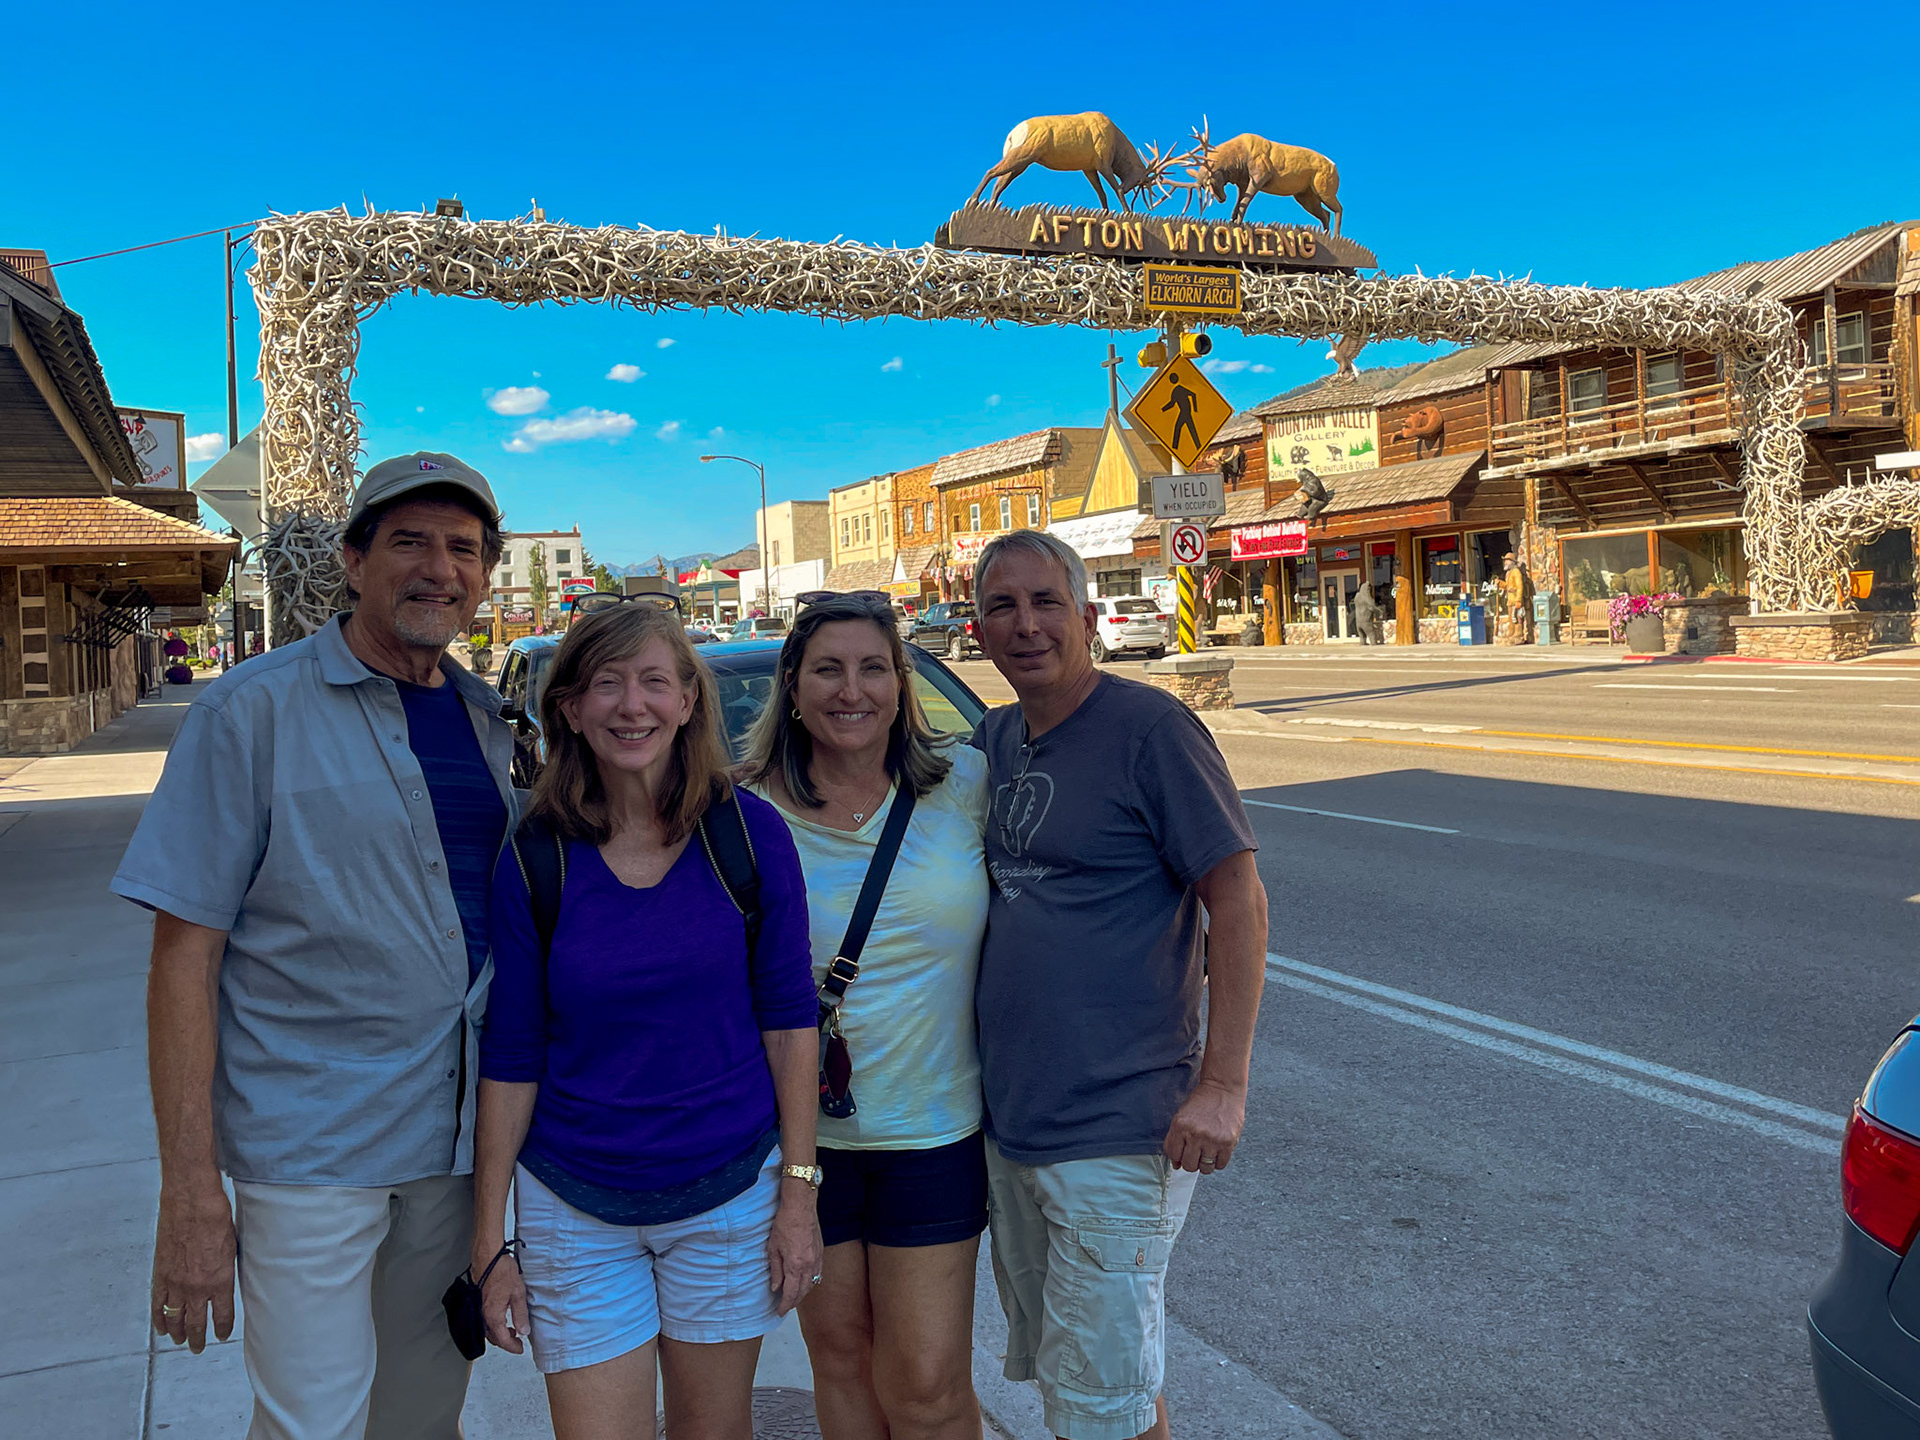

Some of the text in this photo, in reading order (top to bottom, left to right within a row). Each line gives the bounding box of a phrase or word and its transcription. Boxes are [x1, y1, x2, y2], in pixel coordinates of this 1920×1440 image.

[1029, 214, 1316, 259] AFTON WYOMING
[1155, 273, 1230, 286] World's Largest
[1151, 285, 1235, 305] ELKHORN ARCH
[1266, 407, 1372, 440] MOUNTAIN VALLEY
[1294, 430, 1347, 442] GALLERY
[1315, 464, 1348, 475] FURNITURE
[1355, 460, 1375, 470] DECOR
[1170, 482, 1207, 498] YIELD
[1163, 500, 1217, 511] WHEN OCCUPIED
[1241, 526, 1262, 541] Parking
[561, 578, 595, 591] MAVERIK
